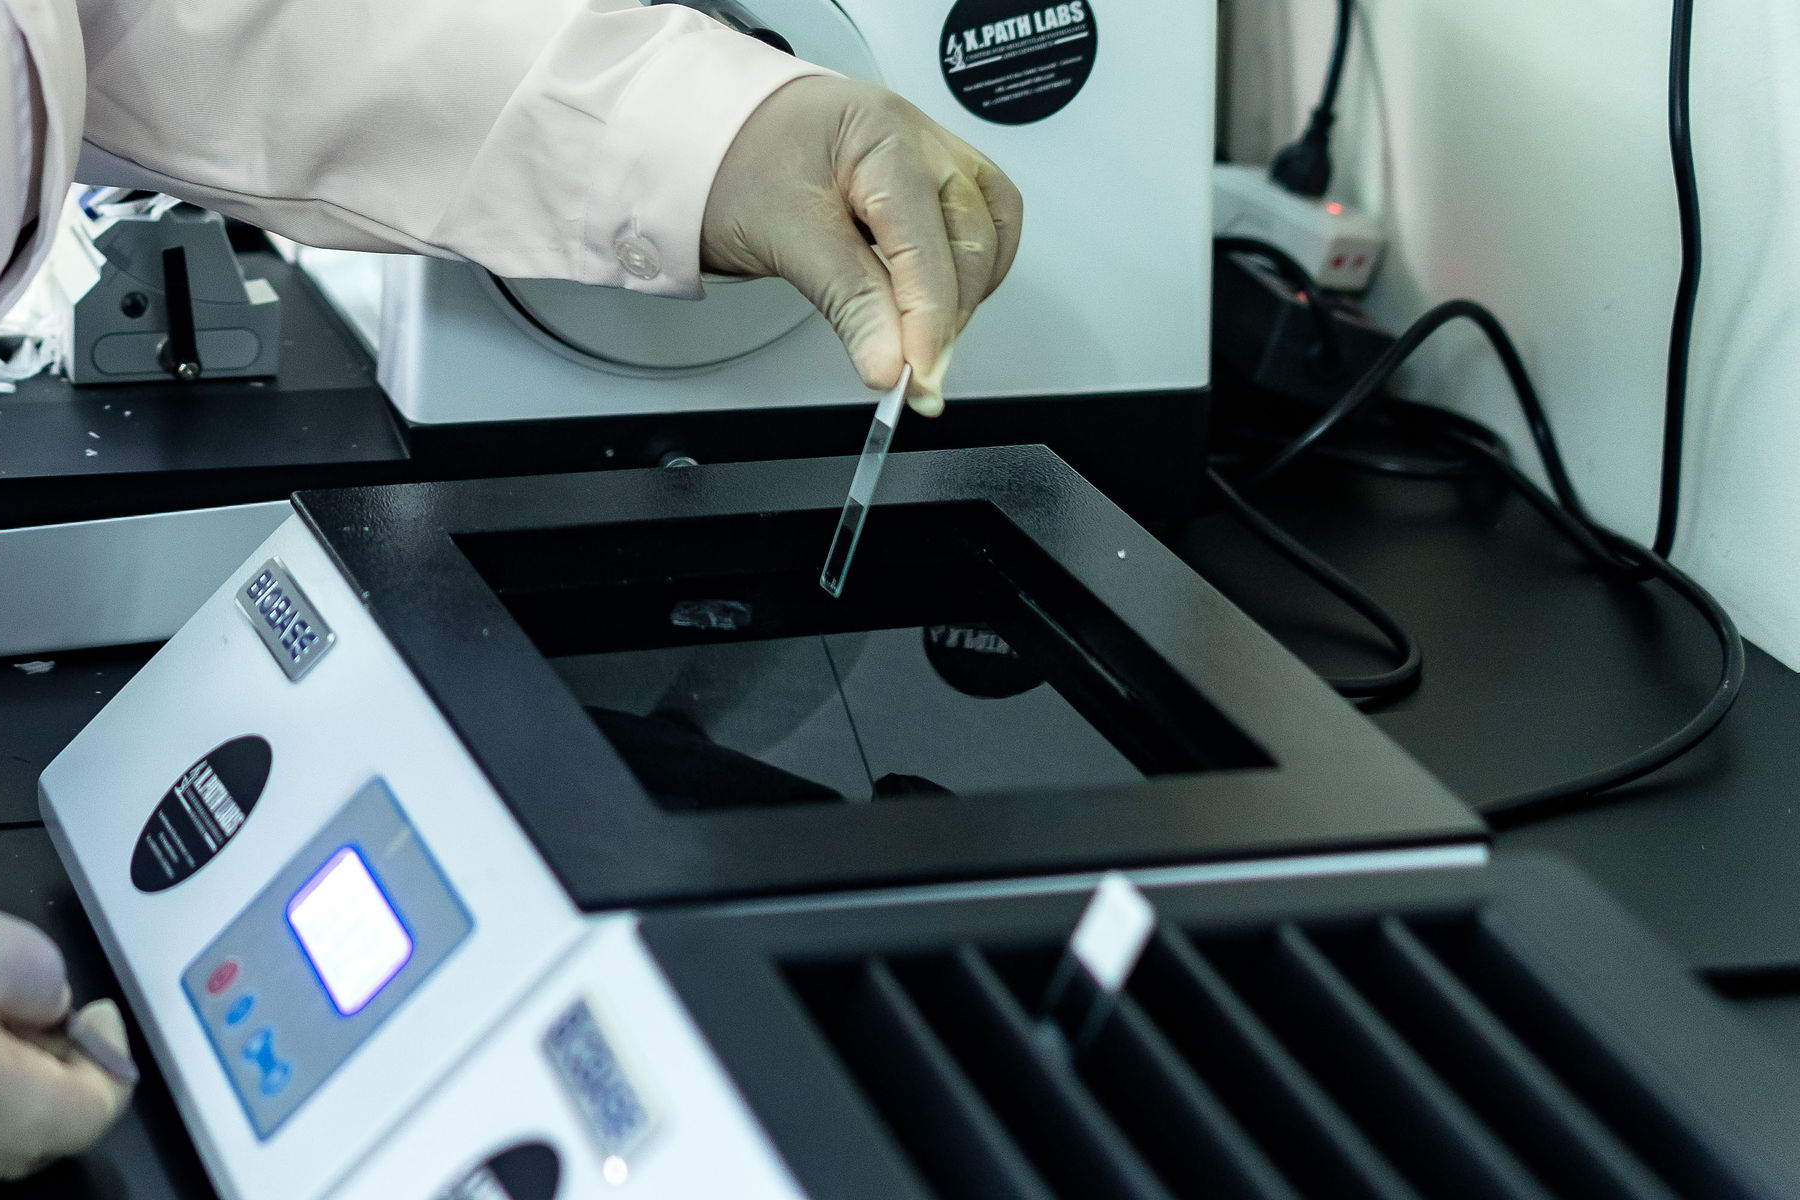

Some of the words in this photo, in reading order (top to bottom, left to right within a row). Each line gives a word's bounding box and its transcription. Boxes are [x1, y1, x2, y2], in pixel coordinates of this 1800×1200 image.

[962, 13, 1033, 53] X.PATH
[1033, 0, 1085, 33] LABS
[246, 568, 319, 664] BIOBASE
